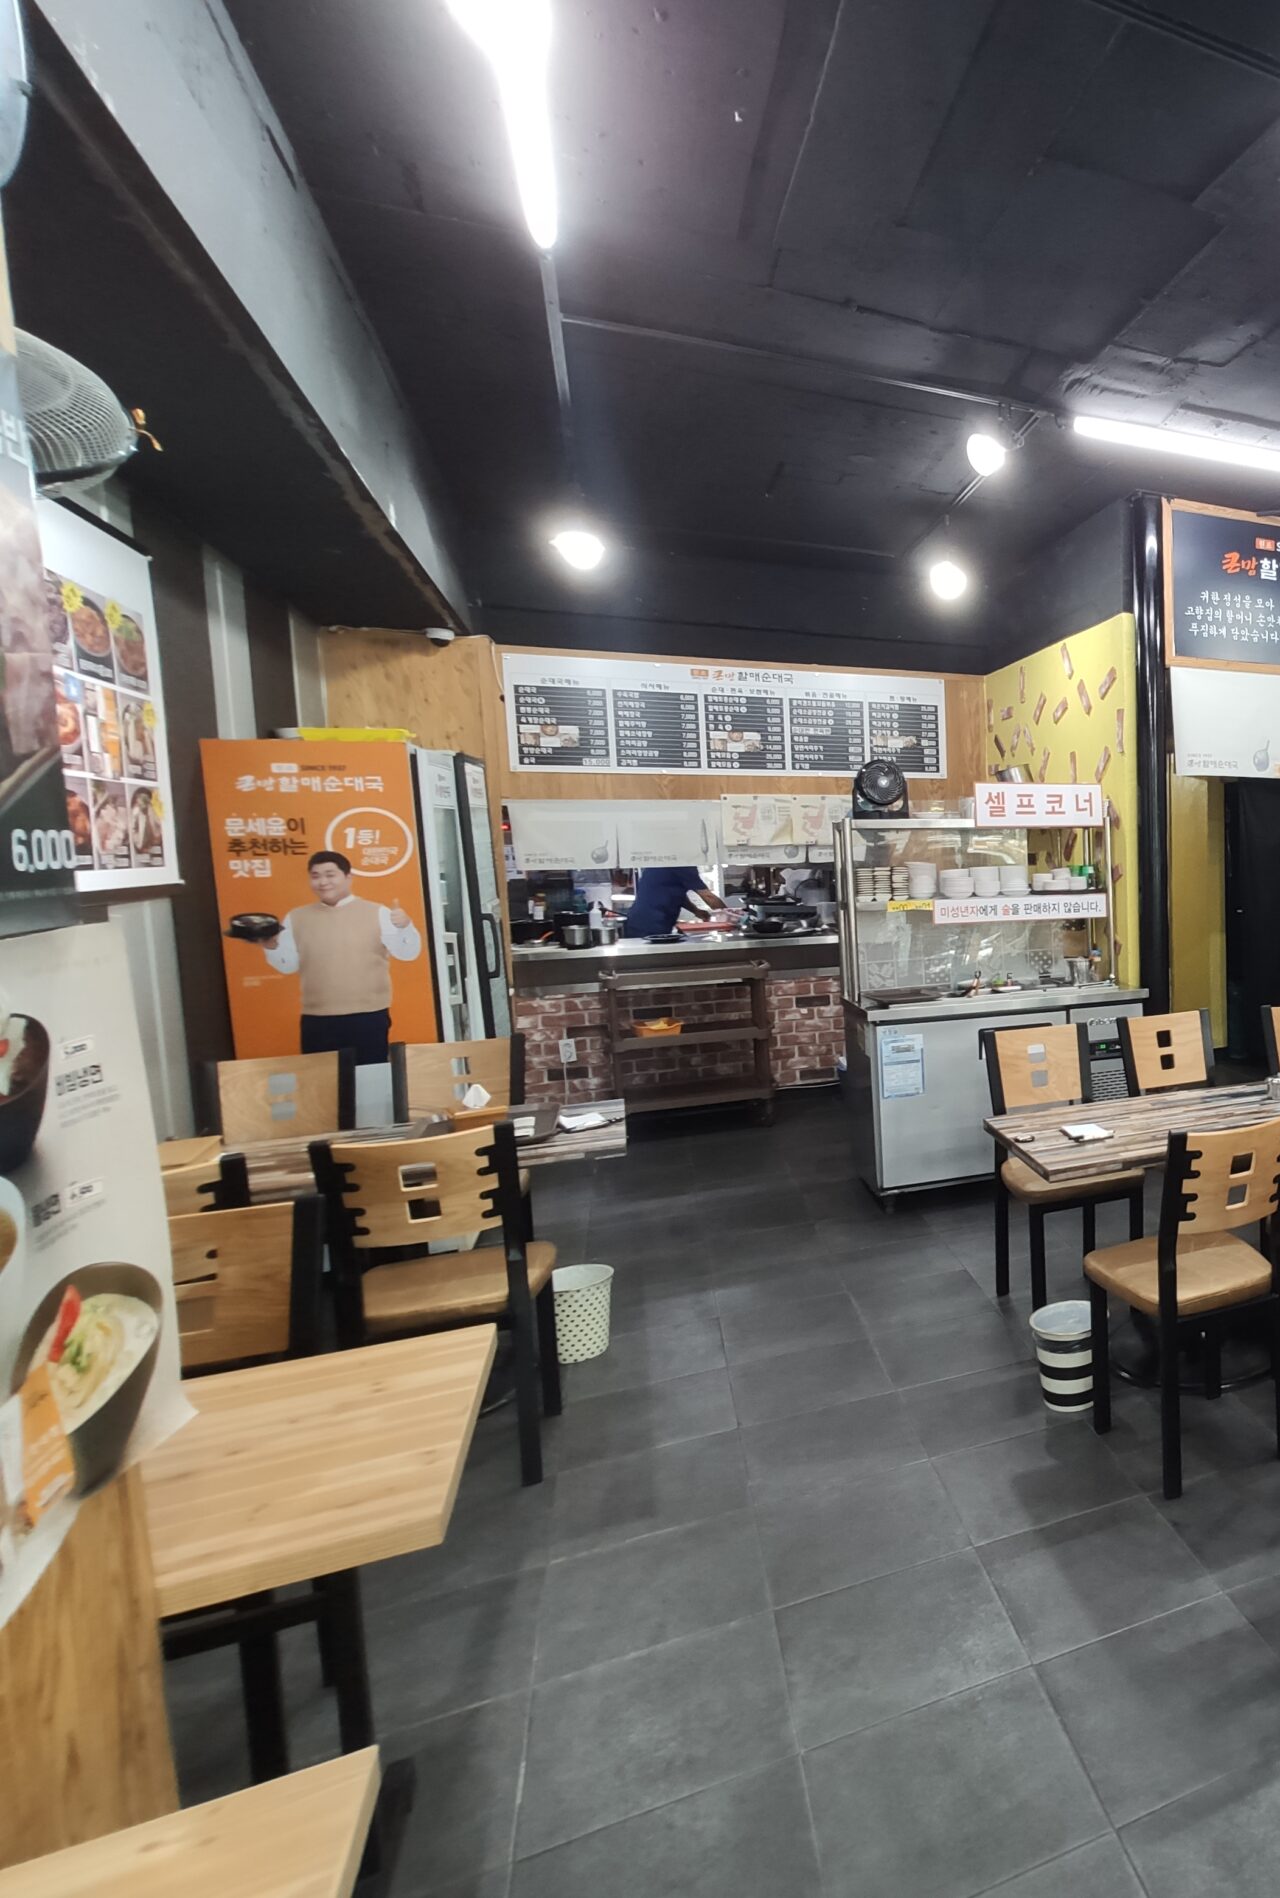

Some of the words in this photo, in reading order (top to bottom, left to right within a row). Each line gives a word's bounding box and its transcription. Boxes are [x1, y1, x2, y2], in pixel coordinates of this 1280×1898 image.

[1222, 551, 1258, 576] 큰맘
[1200, 590, 1220, 605] 귀한
[1223, 593, 1252, 608] 정성을
[1254, 598, 1275, 611] 모아
[1184, 606, 1222, 621] 고향집의
[1226, 611, 1252, 625] 할머니
[1188, 622, 1227, 639] 푸짐하게
[737, 671, 794, 684] 할매순대국
[279, 776, 384, 793] 할매순대국
[984, 791, 1095, 819] 셀프코너
[224, 816, 306, 837] 문세윤이
[226, 837, 310, 857] 추천하는
[343, 826, 380, 850] 1등!
[11, 829, 75, 873] 6,000
[228, 858, 272, 879] 맛집
[940, 904, 998, 919] 미성년자에게
[1002, 904, 1019, 916] 술을
[1023, 902, 1060, 915] 판매하지
[1062, 900, 1102, 914] 않습니다.
